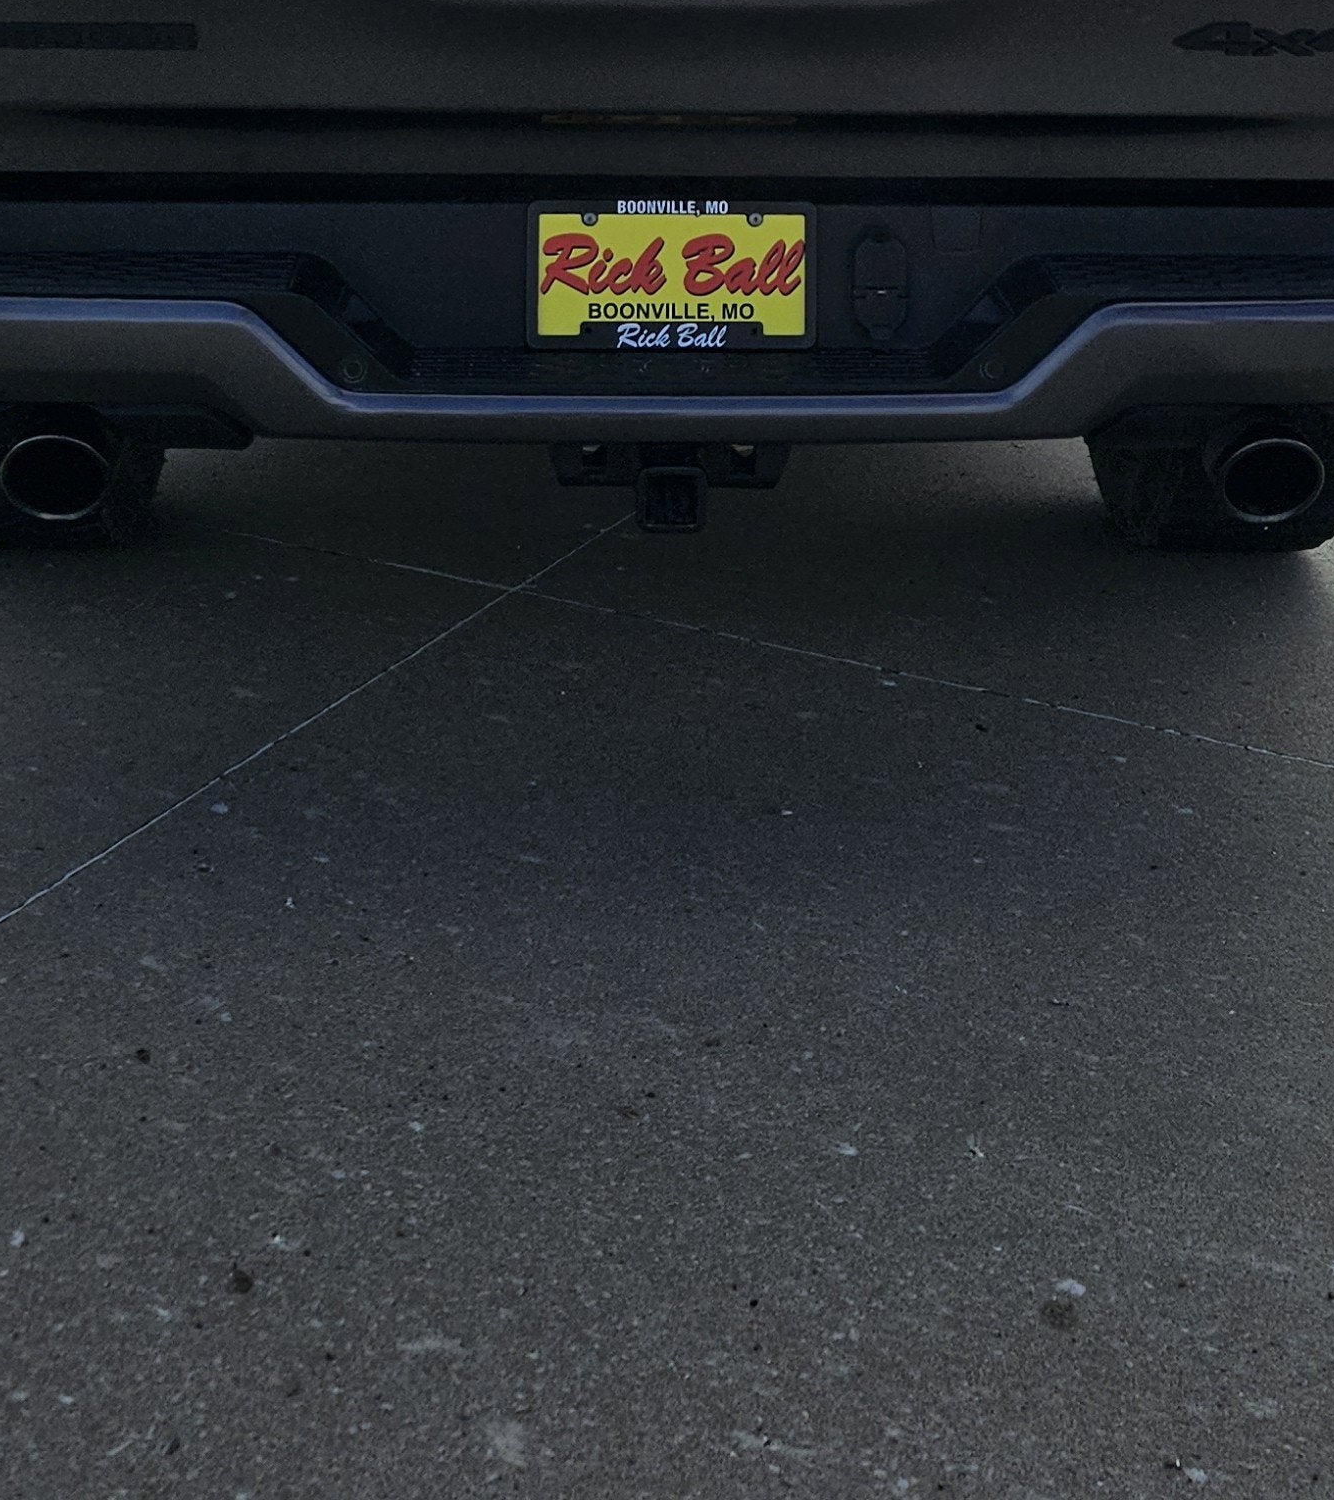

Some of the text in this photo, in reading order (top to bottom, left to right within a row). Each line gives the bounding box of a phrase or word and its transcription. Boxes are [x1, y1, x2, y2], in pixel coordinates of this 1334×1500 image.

[617, 200, 729, 216] BOONVILLE, MO
[541, 233, 805, 295] Rick Ball
[588, 303, 754, 321] BOONVILLE, MO
[616, 323, 727, 348] Rick Ball
